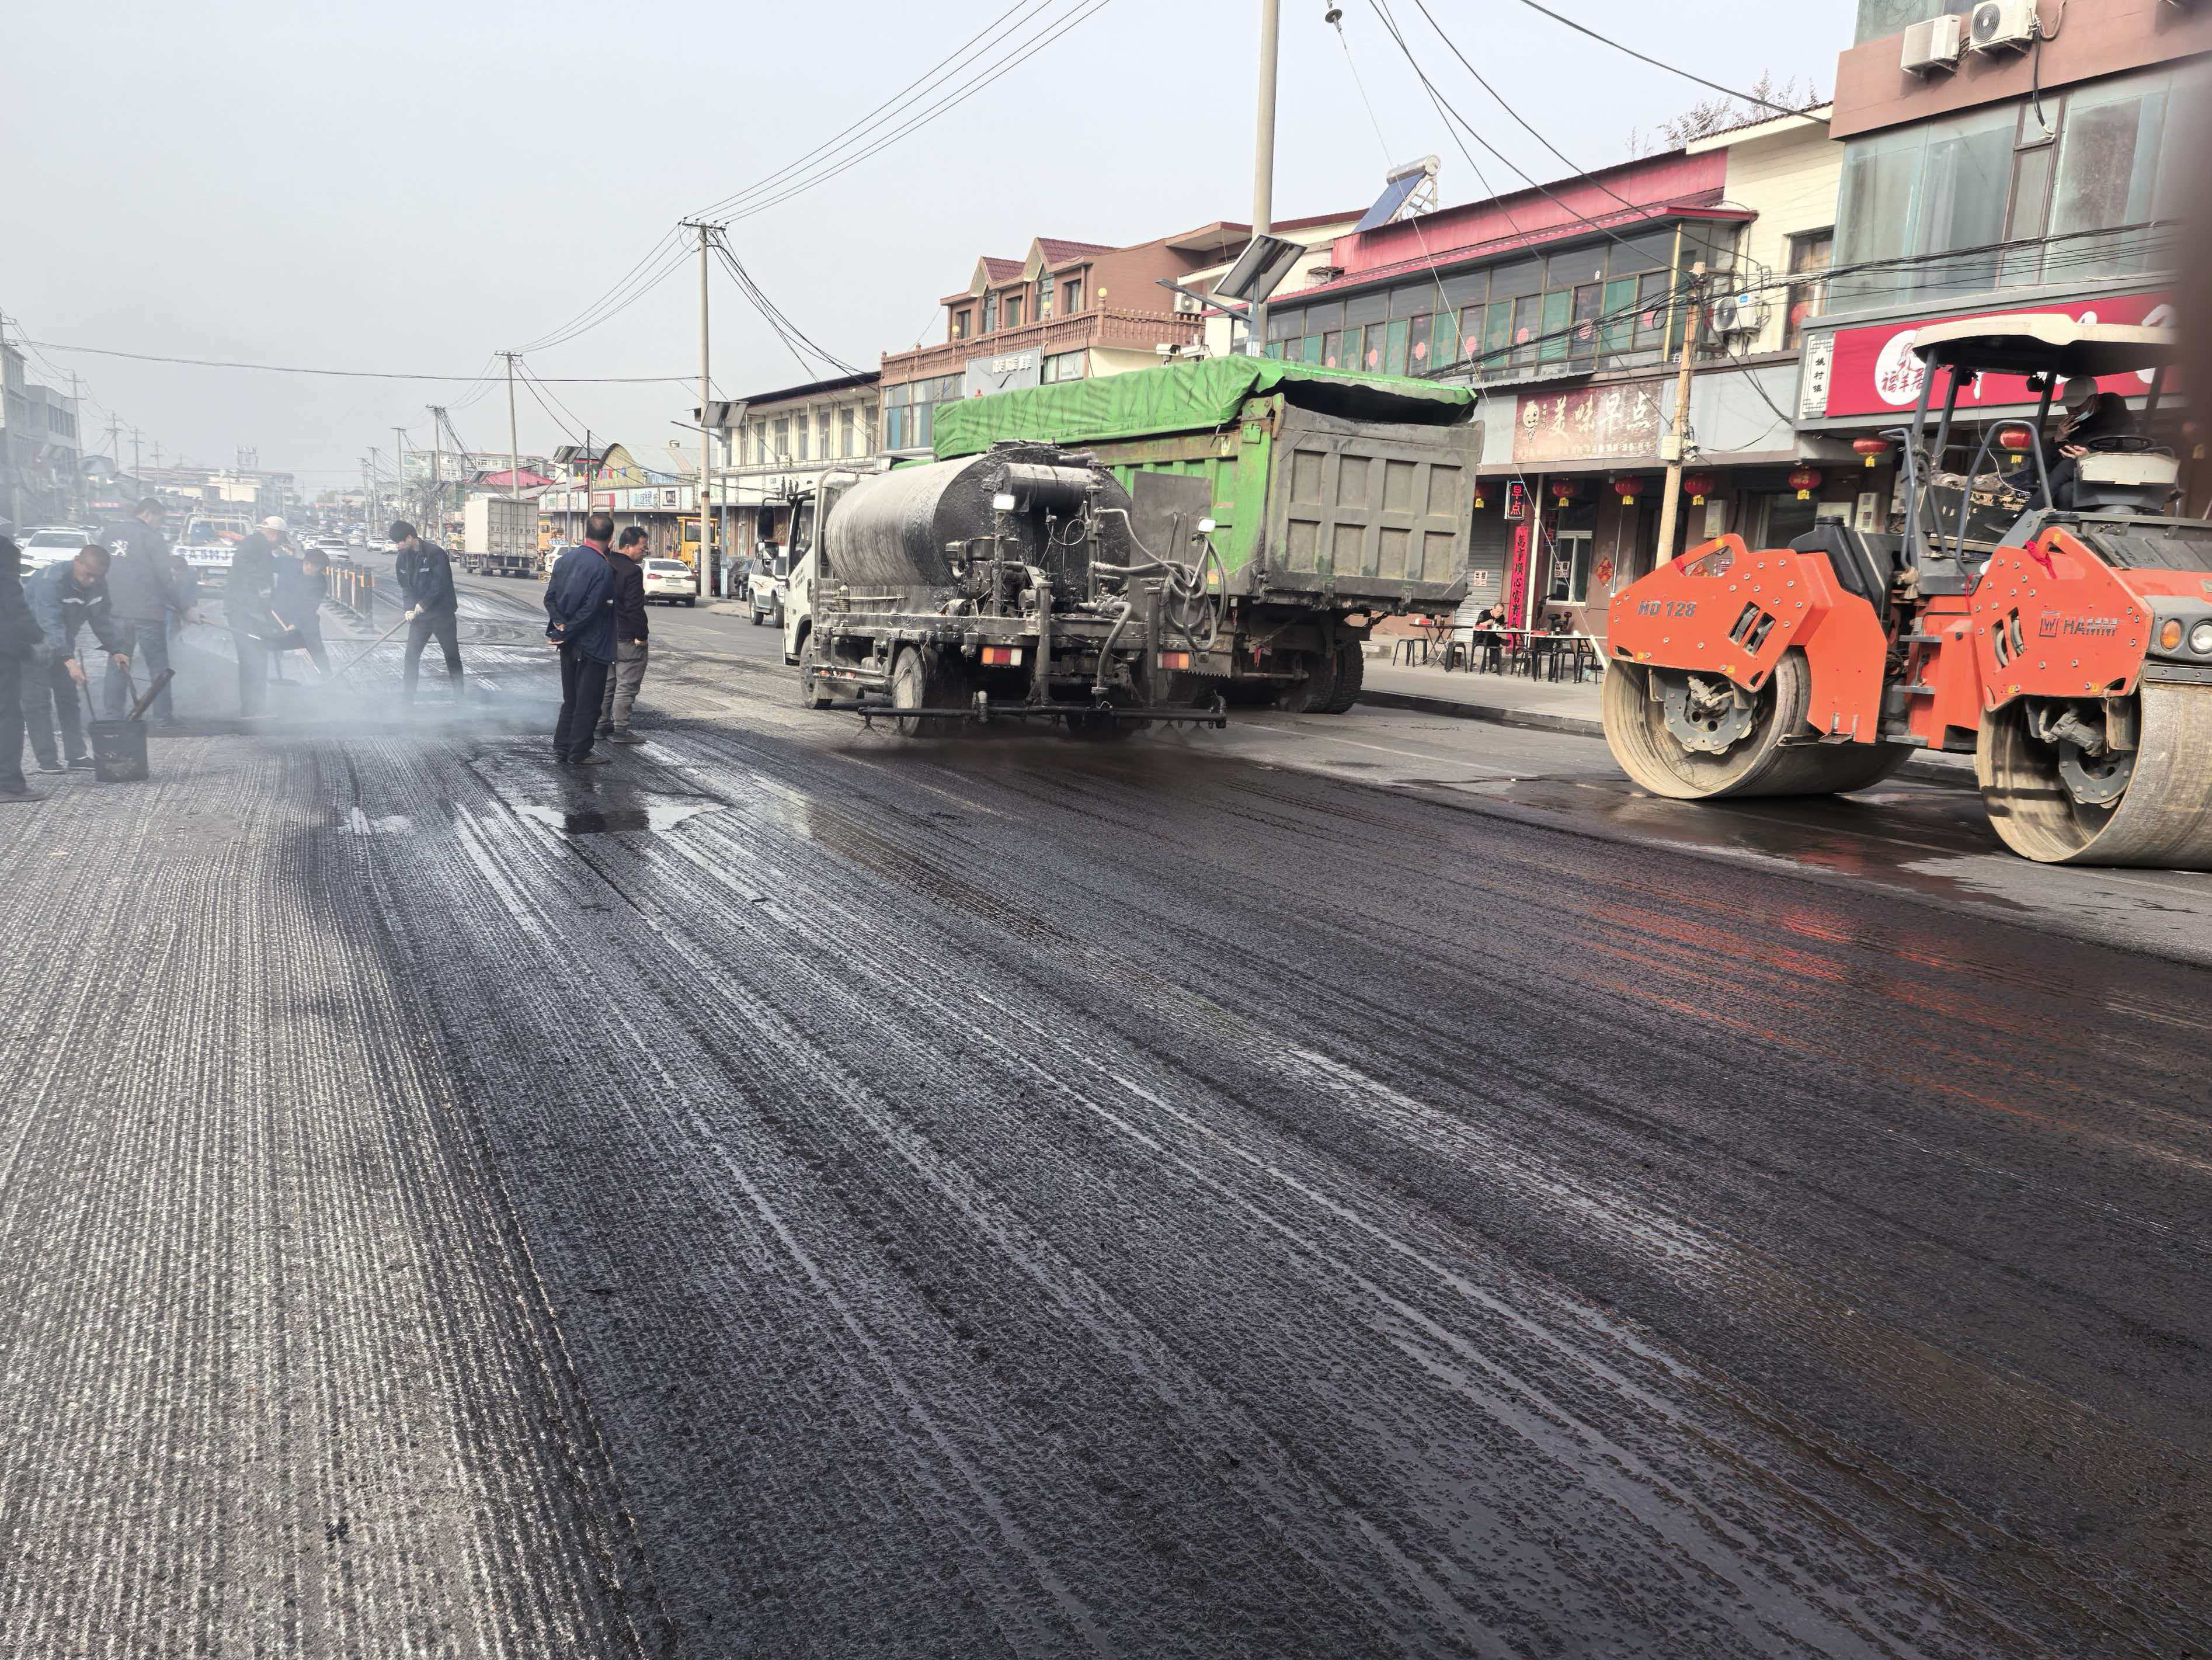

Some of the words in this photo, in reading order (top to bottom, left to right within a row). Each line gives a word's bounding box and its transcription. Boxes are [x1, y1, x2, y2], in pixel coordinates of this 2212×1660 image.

[1548, 391, 1652, 440] 美味早点
[1511, 485, 1522, 515] 早点
[1637, 599, 1661, 616] HD
[1666, 600, 1696, 617] 128
